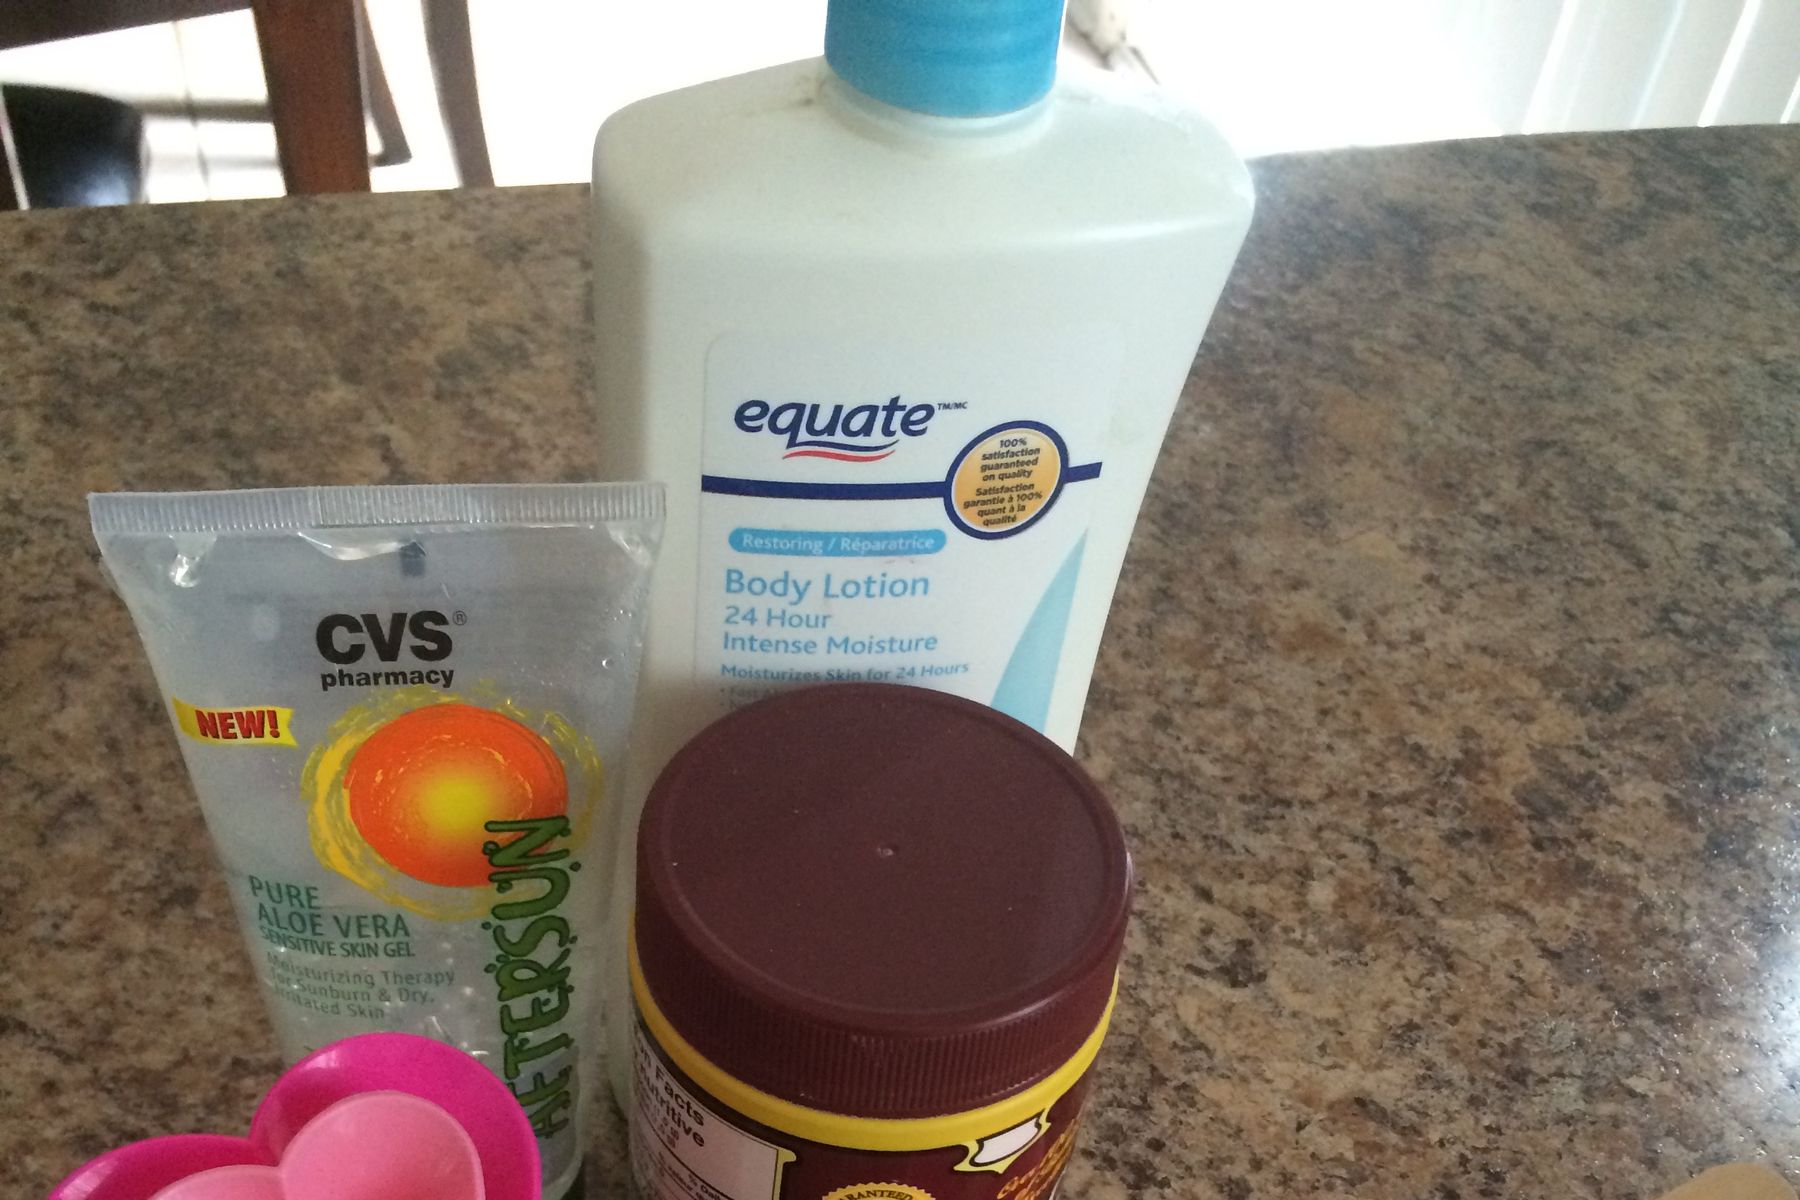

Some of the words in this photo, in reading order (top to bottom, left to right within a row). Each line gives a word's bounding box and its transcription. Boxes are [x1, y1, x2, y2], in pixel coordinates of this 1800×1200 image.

[734, 395, 935, 449] equate
[1000, 438, 1027, 448] 100%
[981, 447, 1041, 461] satisfaction
[980, 457, 1039, 473] guaranteed
[982, 473, 996, 482] on
[998, 469, 1033, 481] quality
[975, 483, 1035, 496] Satisfaction
[963, 496, 1006, 509] garantie
[1016, 491, 1043, 502] 100%
[977, 507, 1006, 518] quant
[1017, 504, 1026, 512] la
[982, 515, 1017, 526] qualité
[743, 535, 823, 554] Restoring
[840, 535, 935, 554] Réparatrice
[725, 568, 811, 605] Body
[825, 572, 930, 599] Lotion
[724, 605, 758, 627] 24
[767, 608, 831, 629] Hour
[316, 610, 454, 665] CVS
[723, 632, 817, 655] Intense
[826, 634, 938, 656] Moisture
[320, 668, 455, 691] pharmacy
[721, 663, 821, 682] Moisturizes
[826, 668, 861, 682] Skin
[867, 668, 890, 681] for
[897, 666, 916, 677] 24
[921, 662, 969, 677] Hours
[196, 709, 281, 741] NEW!
[249, 875, 322, 910] PURE
[258, 902, 324, 936] ALOE
[333, 914, 411, 939] VERA
[260, 926, 337, 956] SENSITIVE
[341, 942, 379, 958] SKIN
[384, 942, 416, 957] GEL
[381, 970, 455, 987] Therapy
[347, 1004, 385, 1020] Skin
[655, 1065, 704, 1126] Facts
